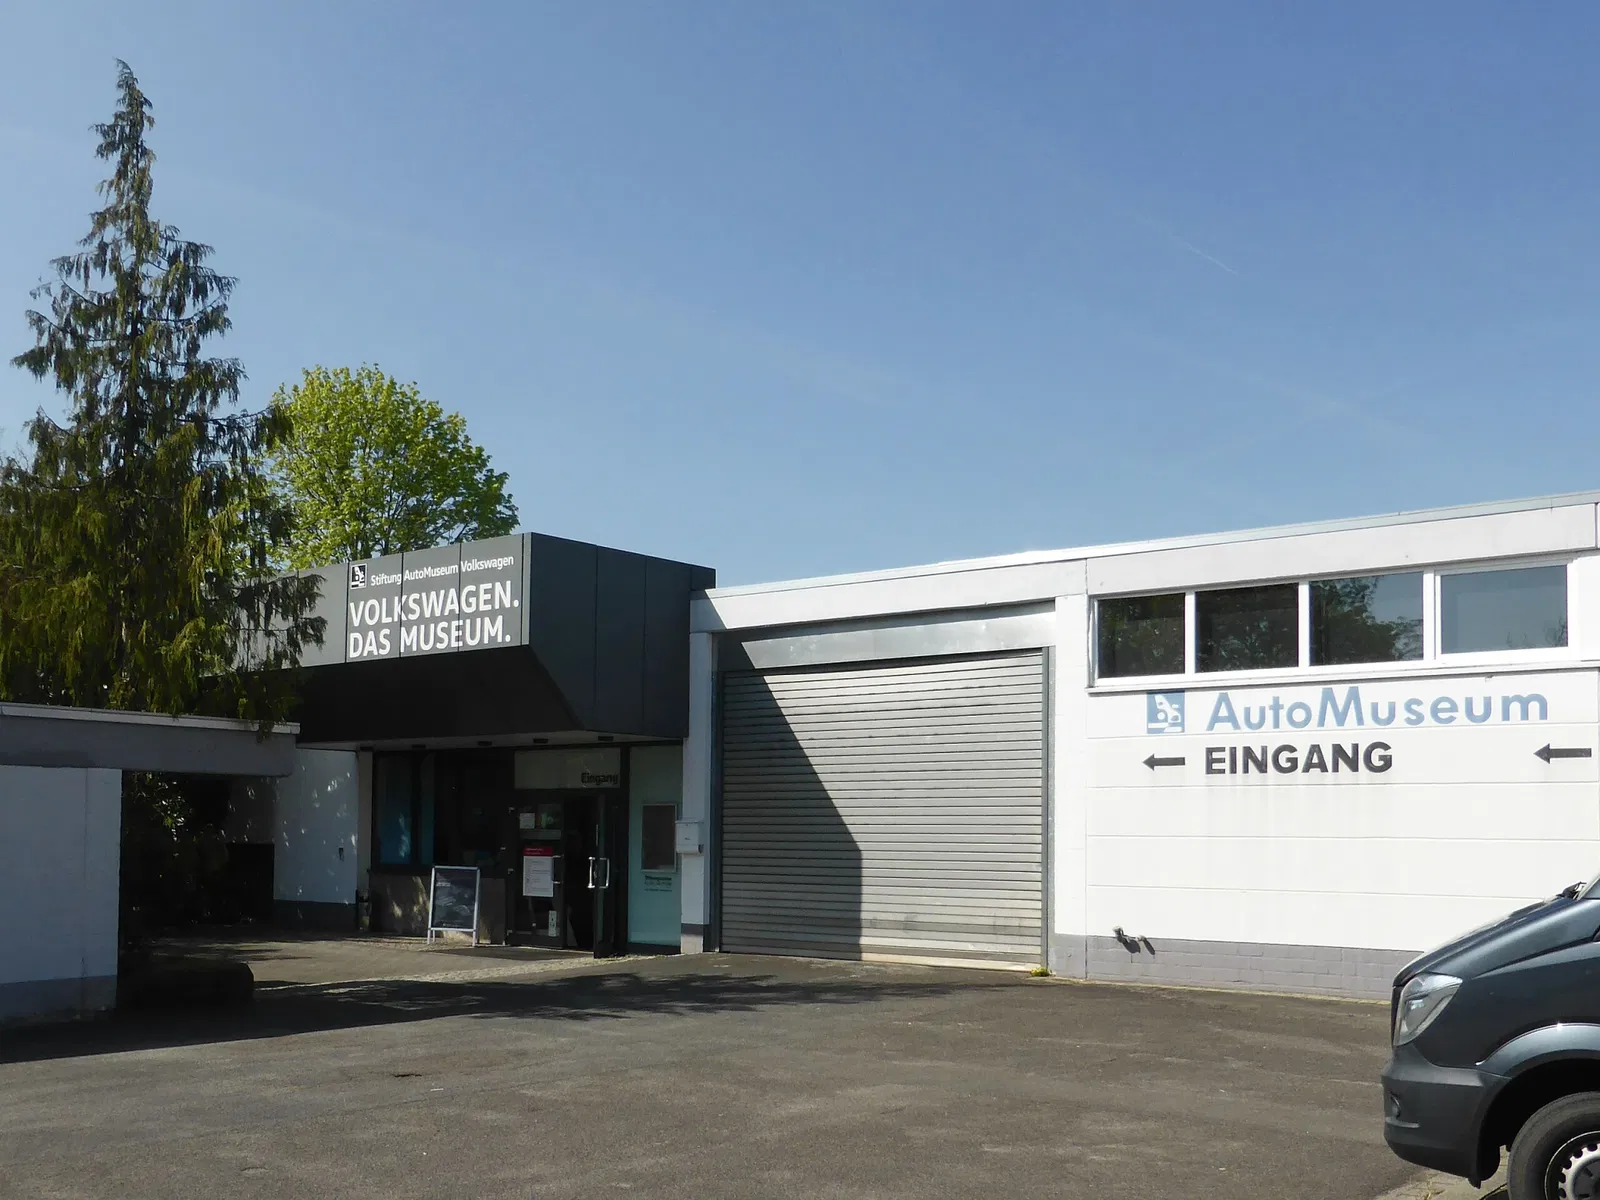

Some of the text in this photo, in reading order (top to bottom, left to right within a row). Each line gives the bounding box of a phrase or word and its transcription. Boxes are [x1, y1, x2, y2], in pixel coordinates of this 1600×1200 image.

[370, 556, 514, 587] Stiftung AutoMuseum Volkswagen
[349, 580, 520, 627] VOLKSWAGEN.
[349, 615, 511, 658] DAS MUSEUM.
[1205, 686, 1548, 732] AutoMuseum
[1205, 741, 1393, 775] EINGANG
